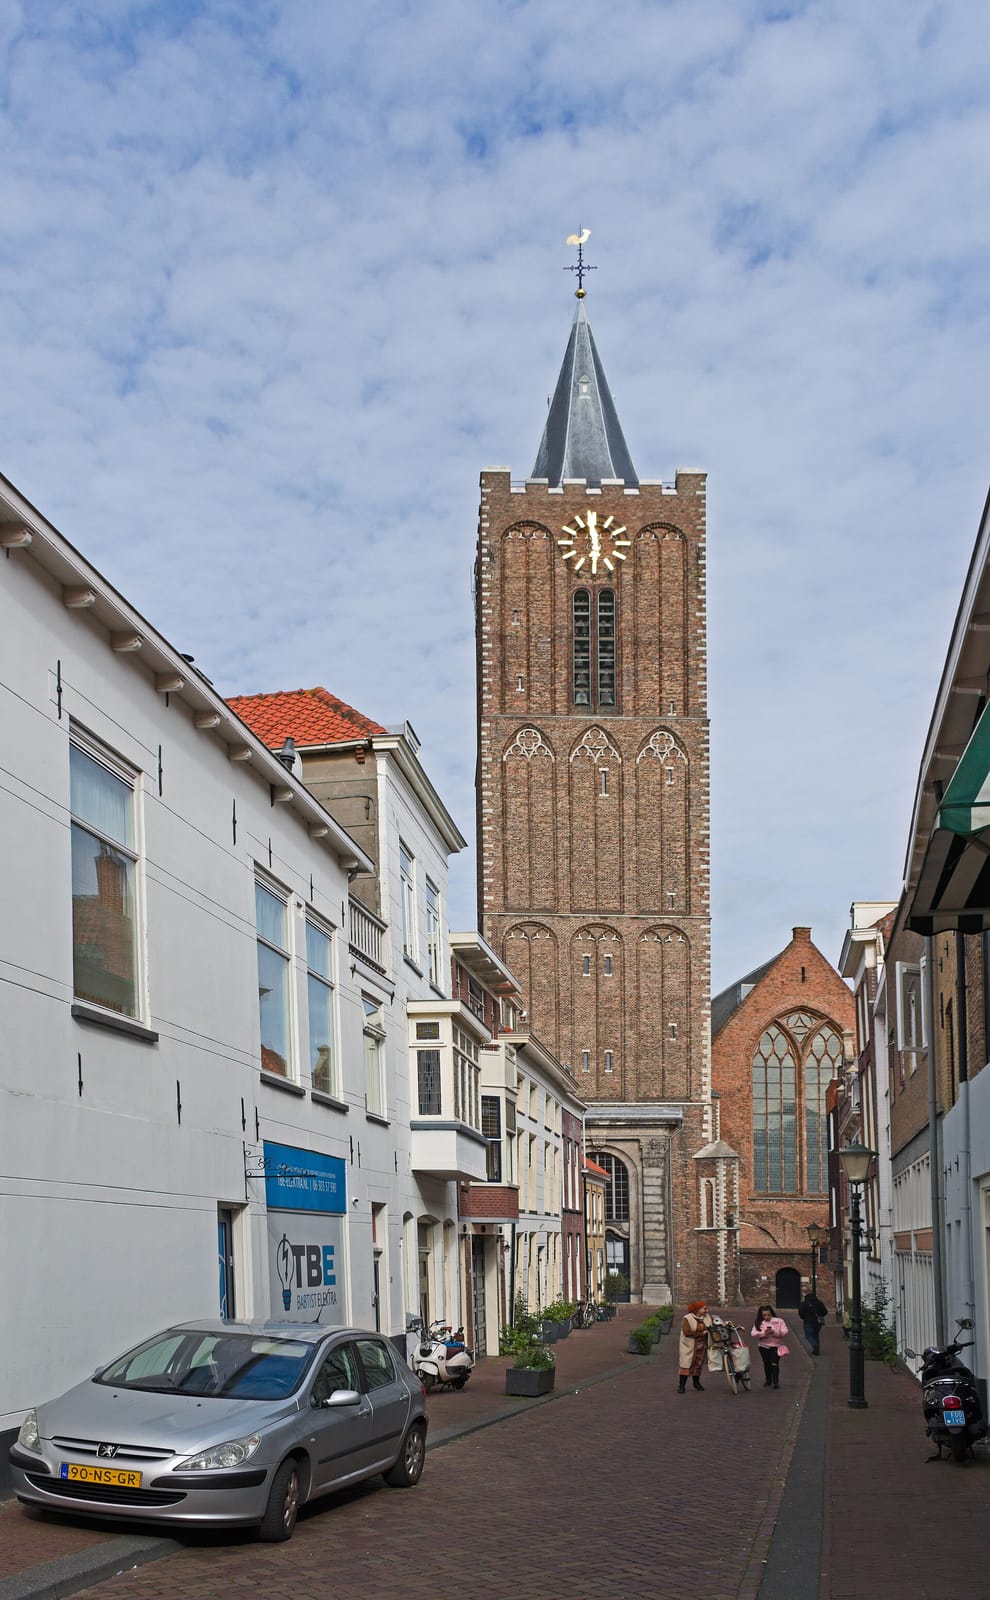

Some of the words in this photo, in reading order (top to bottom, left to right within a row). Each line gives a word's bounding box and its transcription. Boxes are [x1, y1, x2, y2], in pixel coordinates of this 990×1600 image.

[291, 1245, 336, 1288] TBE
[317, 1290, 337, 1307] ELEKTRA
[71, 1467, 136, 1485] 90-NS-GR
